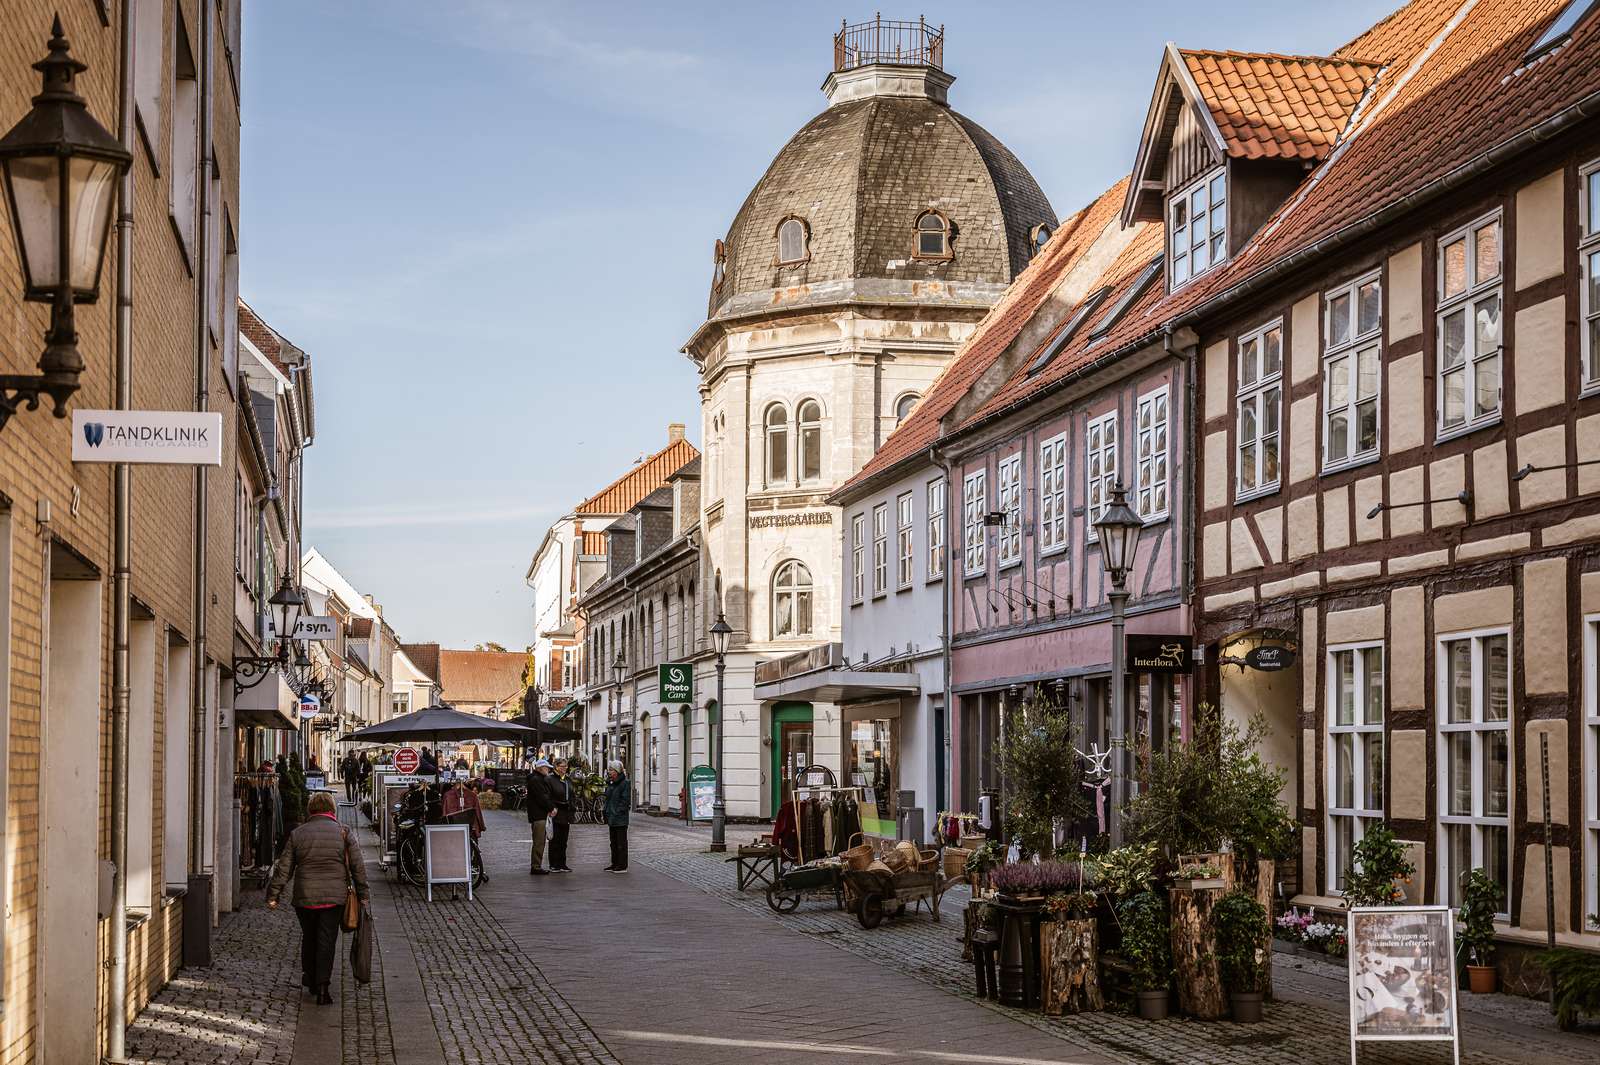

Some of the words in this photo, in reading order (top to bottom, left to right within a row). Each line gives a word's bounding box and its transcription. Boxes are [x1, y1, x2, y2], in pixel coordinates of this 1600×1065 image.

[107, 426, 208, 441] TANDKLINIK
[306, 623, 331, 634] syn.
[1134, 657, 1173, 666] Interflora
